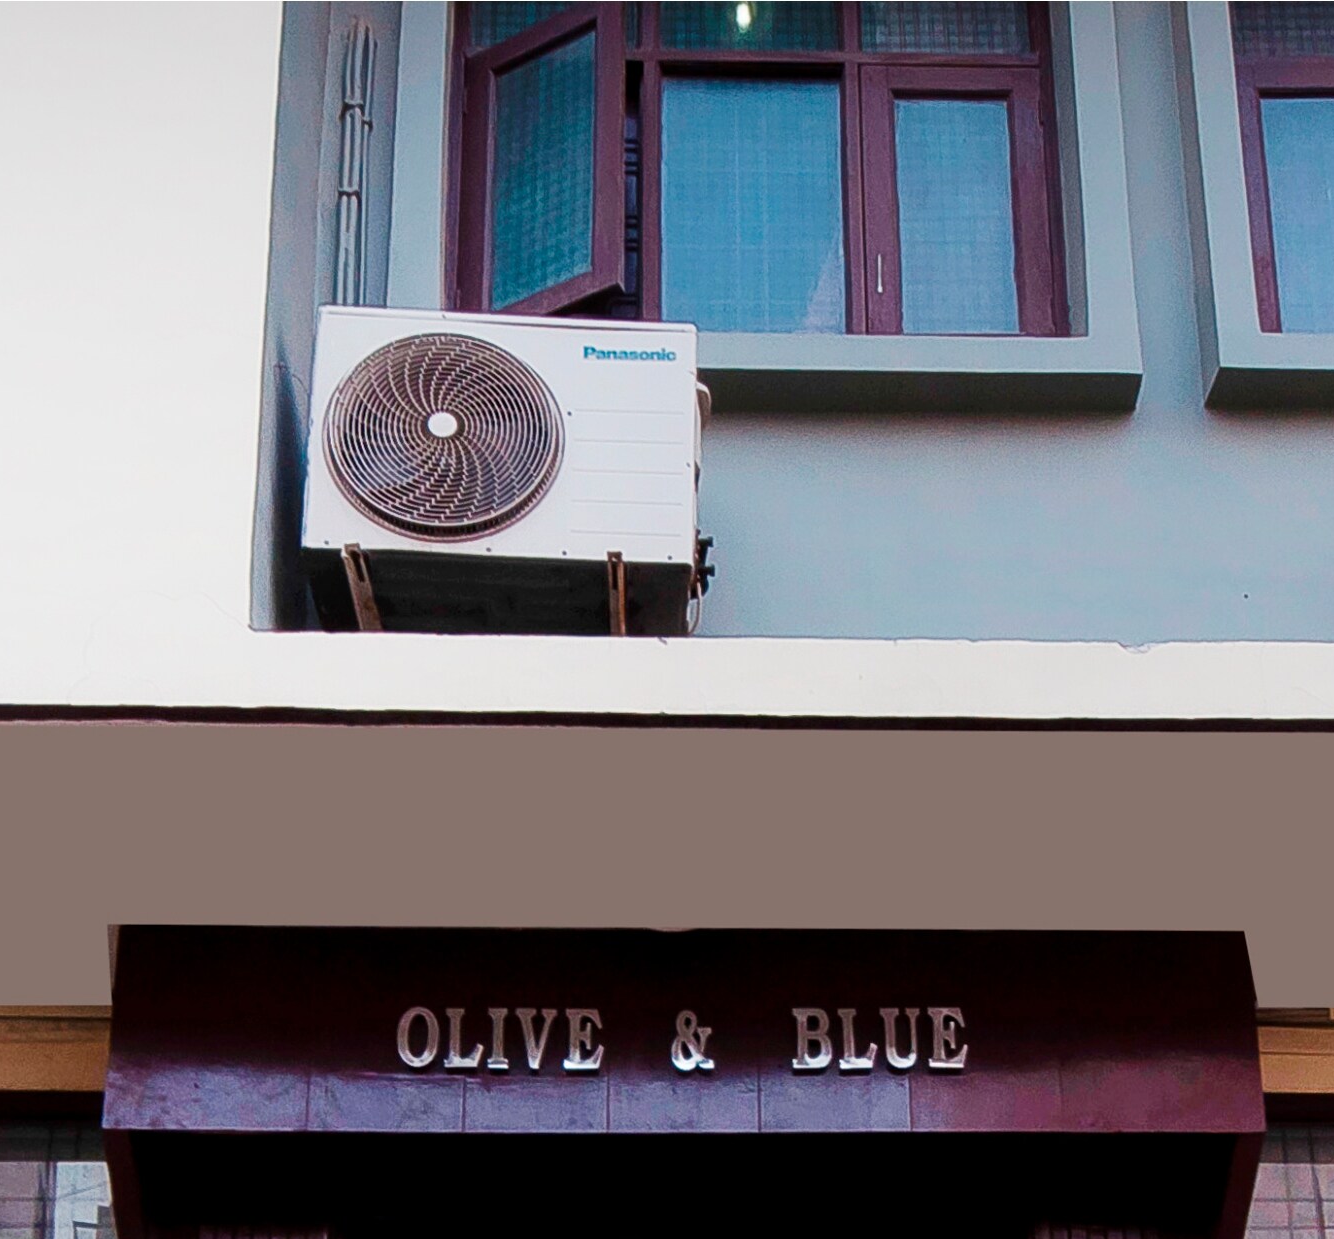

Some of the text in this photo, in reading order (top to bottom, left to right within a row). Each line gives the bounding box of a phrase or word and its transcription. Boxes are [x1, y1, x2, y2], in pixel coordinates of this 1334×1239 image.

[582, 345, 677, 361] Panasonic
[396, 1006, 969, 1072] OLIVE & BLUE
